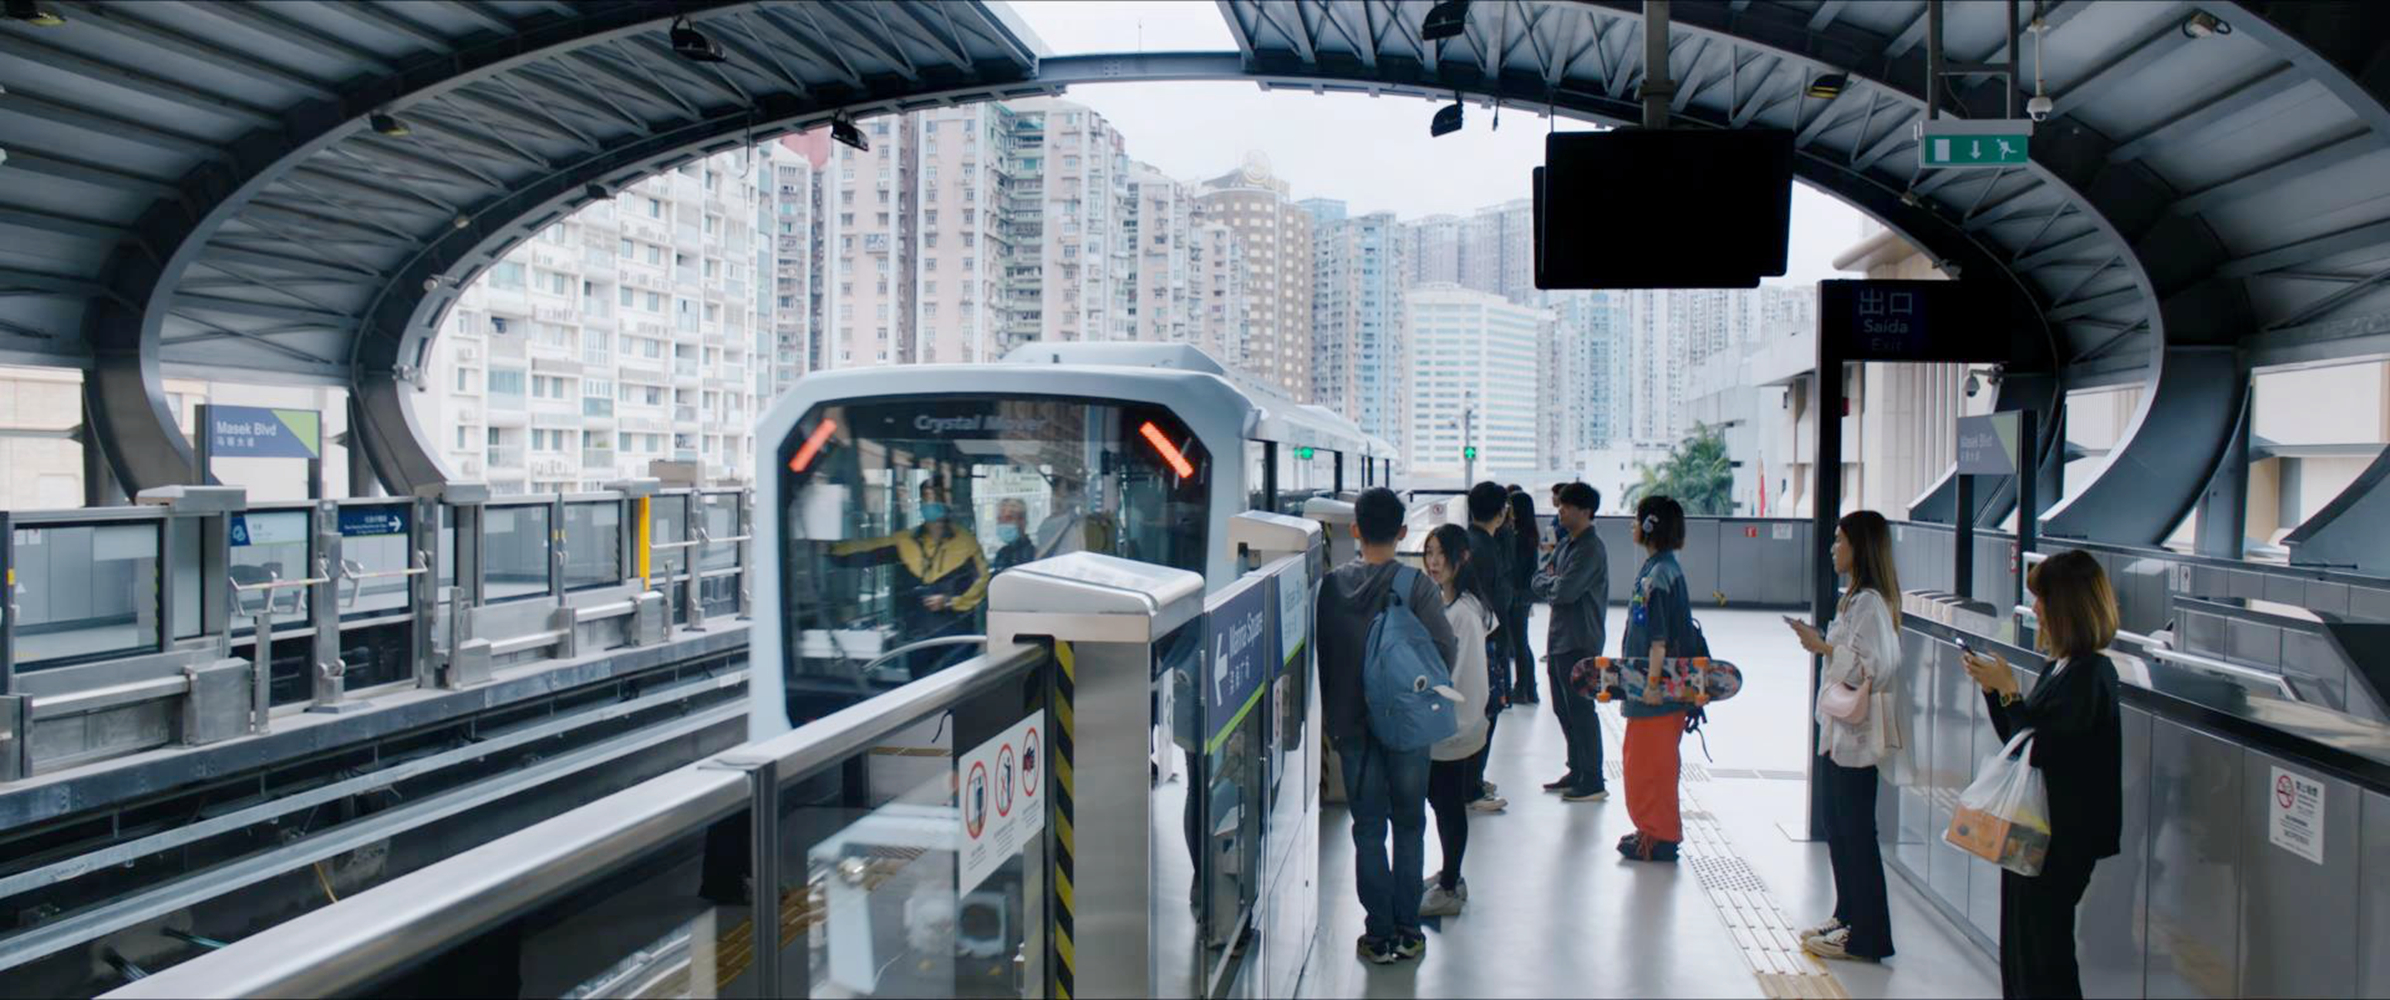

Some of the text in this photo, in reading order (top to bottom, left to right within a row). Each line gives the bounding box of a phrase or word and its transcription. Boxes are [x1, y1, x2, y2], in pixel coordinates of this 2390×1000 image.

[1859, 288, 1913, 316] 出口
[1871, 338, 1903, 352] Exit
[216, 421, 277, 437] Masek Blvd
[914, 415, 982, 434] Crystal
